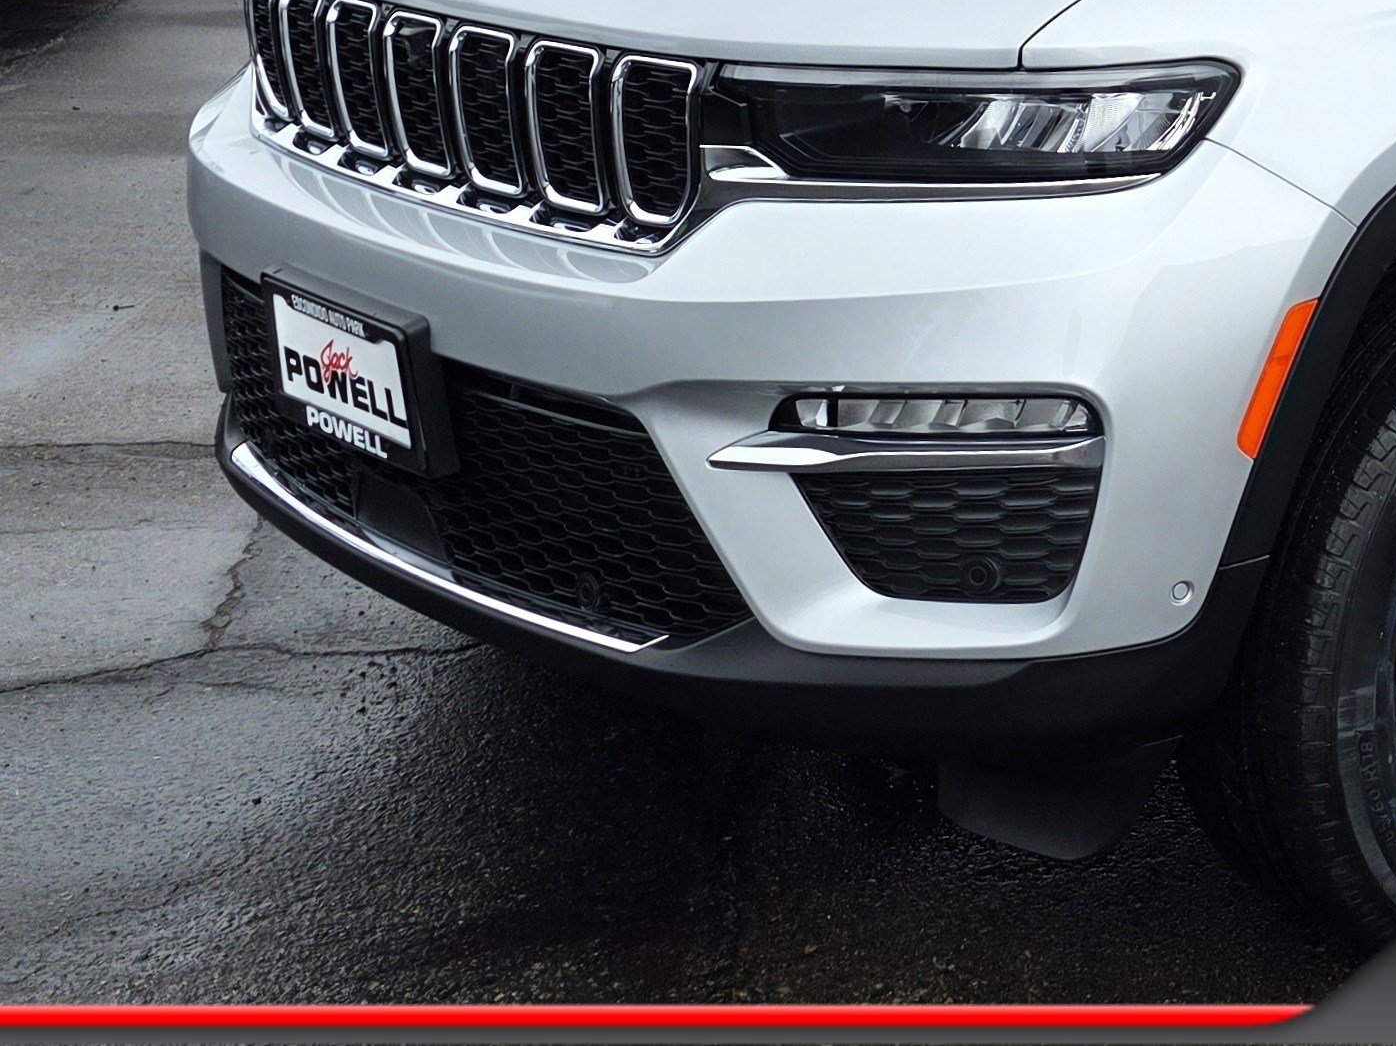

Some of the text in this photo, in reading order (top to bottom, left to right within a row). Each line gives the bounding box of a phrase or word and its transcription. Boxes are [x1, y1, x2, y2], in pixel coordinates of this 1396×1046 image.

[284, 346, 408, 429] POWELL
[320, 338, 358, 384] Jack
[306, 404, 388, 460] POWELL
